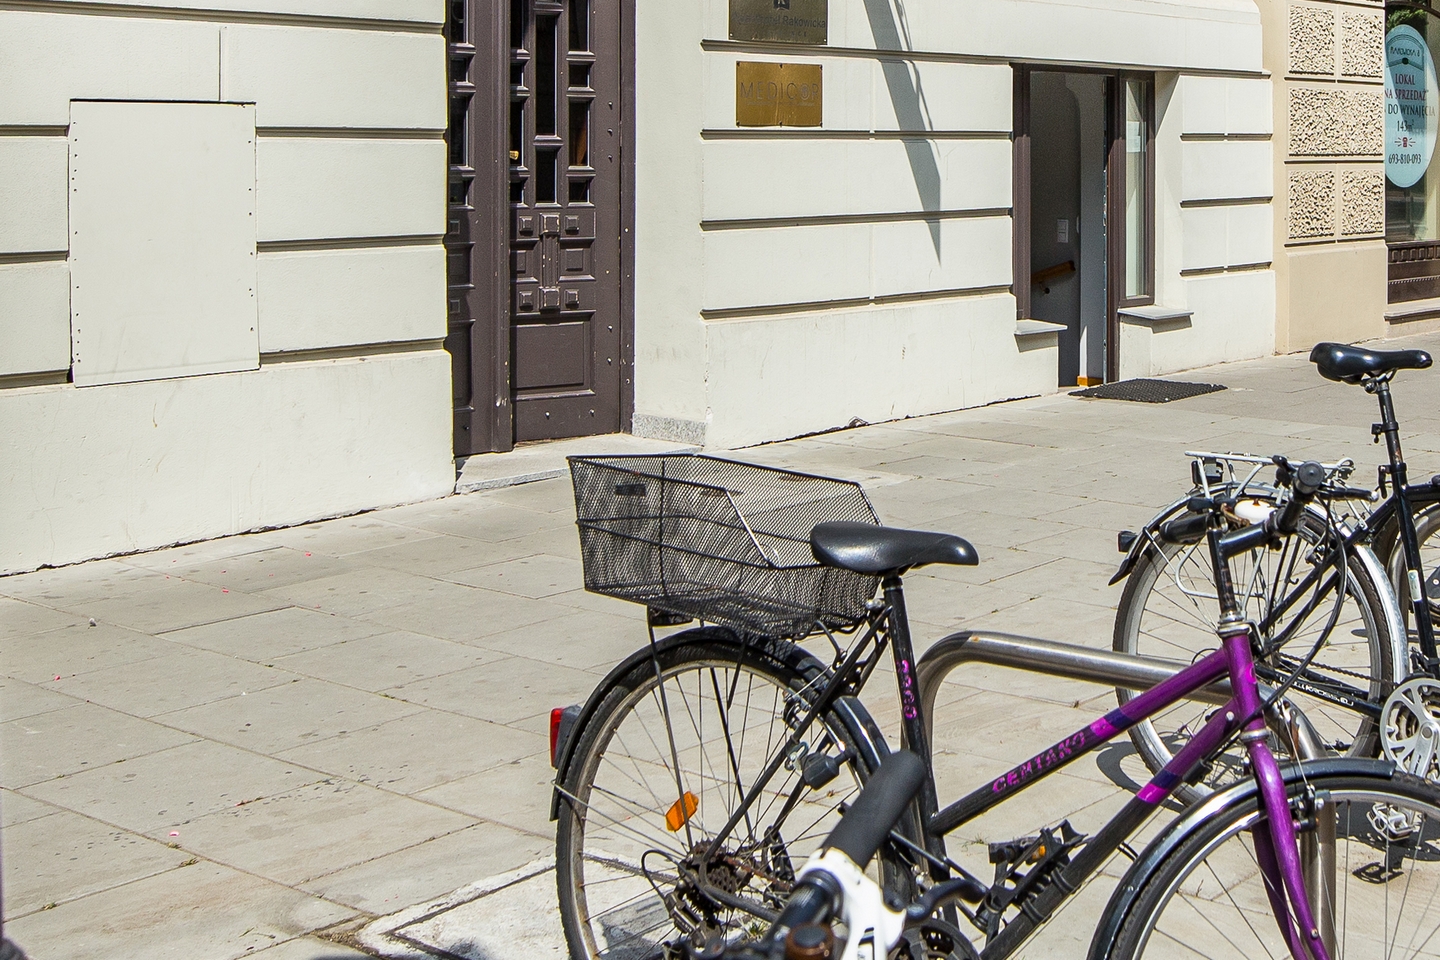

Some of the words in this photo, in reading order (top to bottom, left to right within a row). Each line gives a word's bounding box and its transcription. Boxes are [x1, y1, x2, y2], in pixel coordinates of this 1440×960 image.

[782, 15, 826, 28] Rakowicka
[1395, 73, 1415, 86] LOKAL
[1388, 104, 1398, 115] DO
